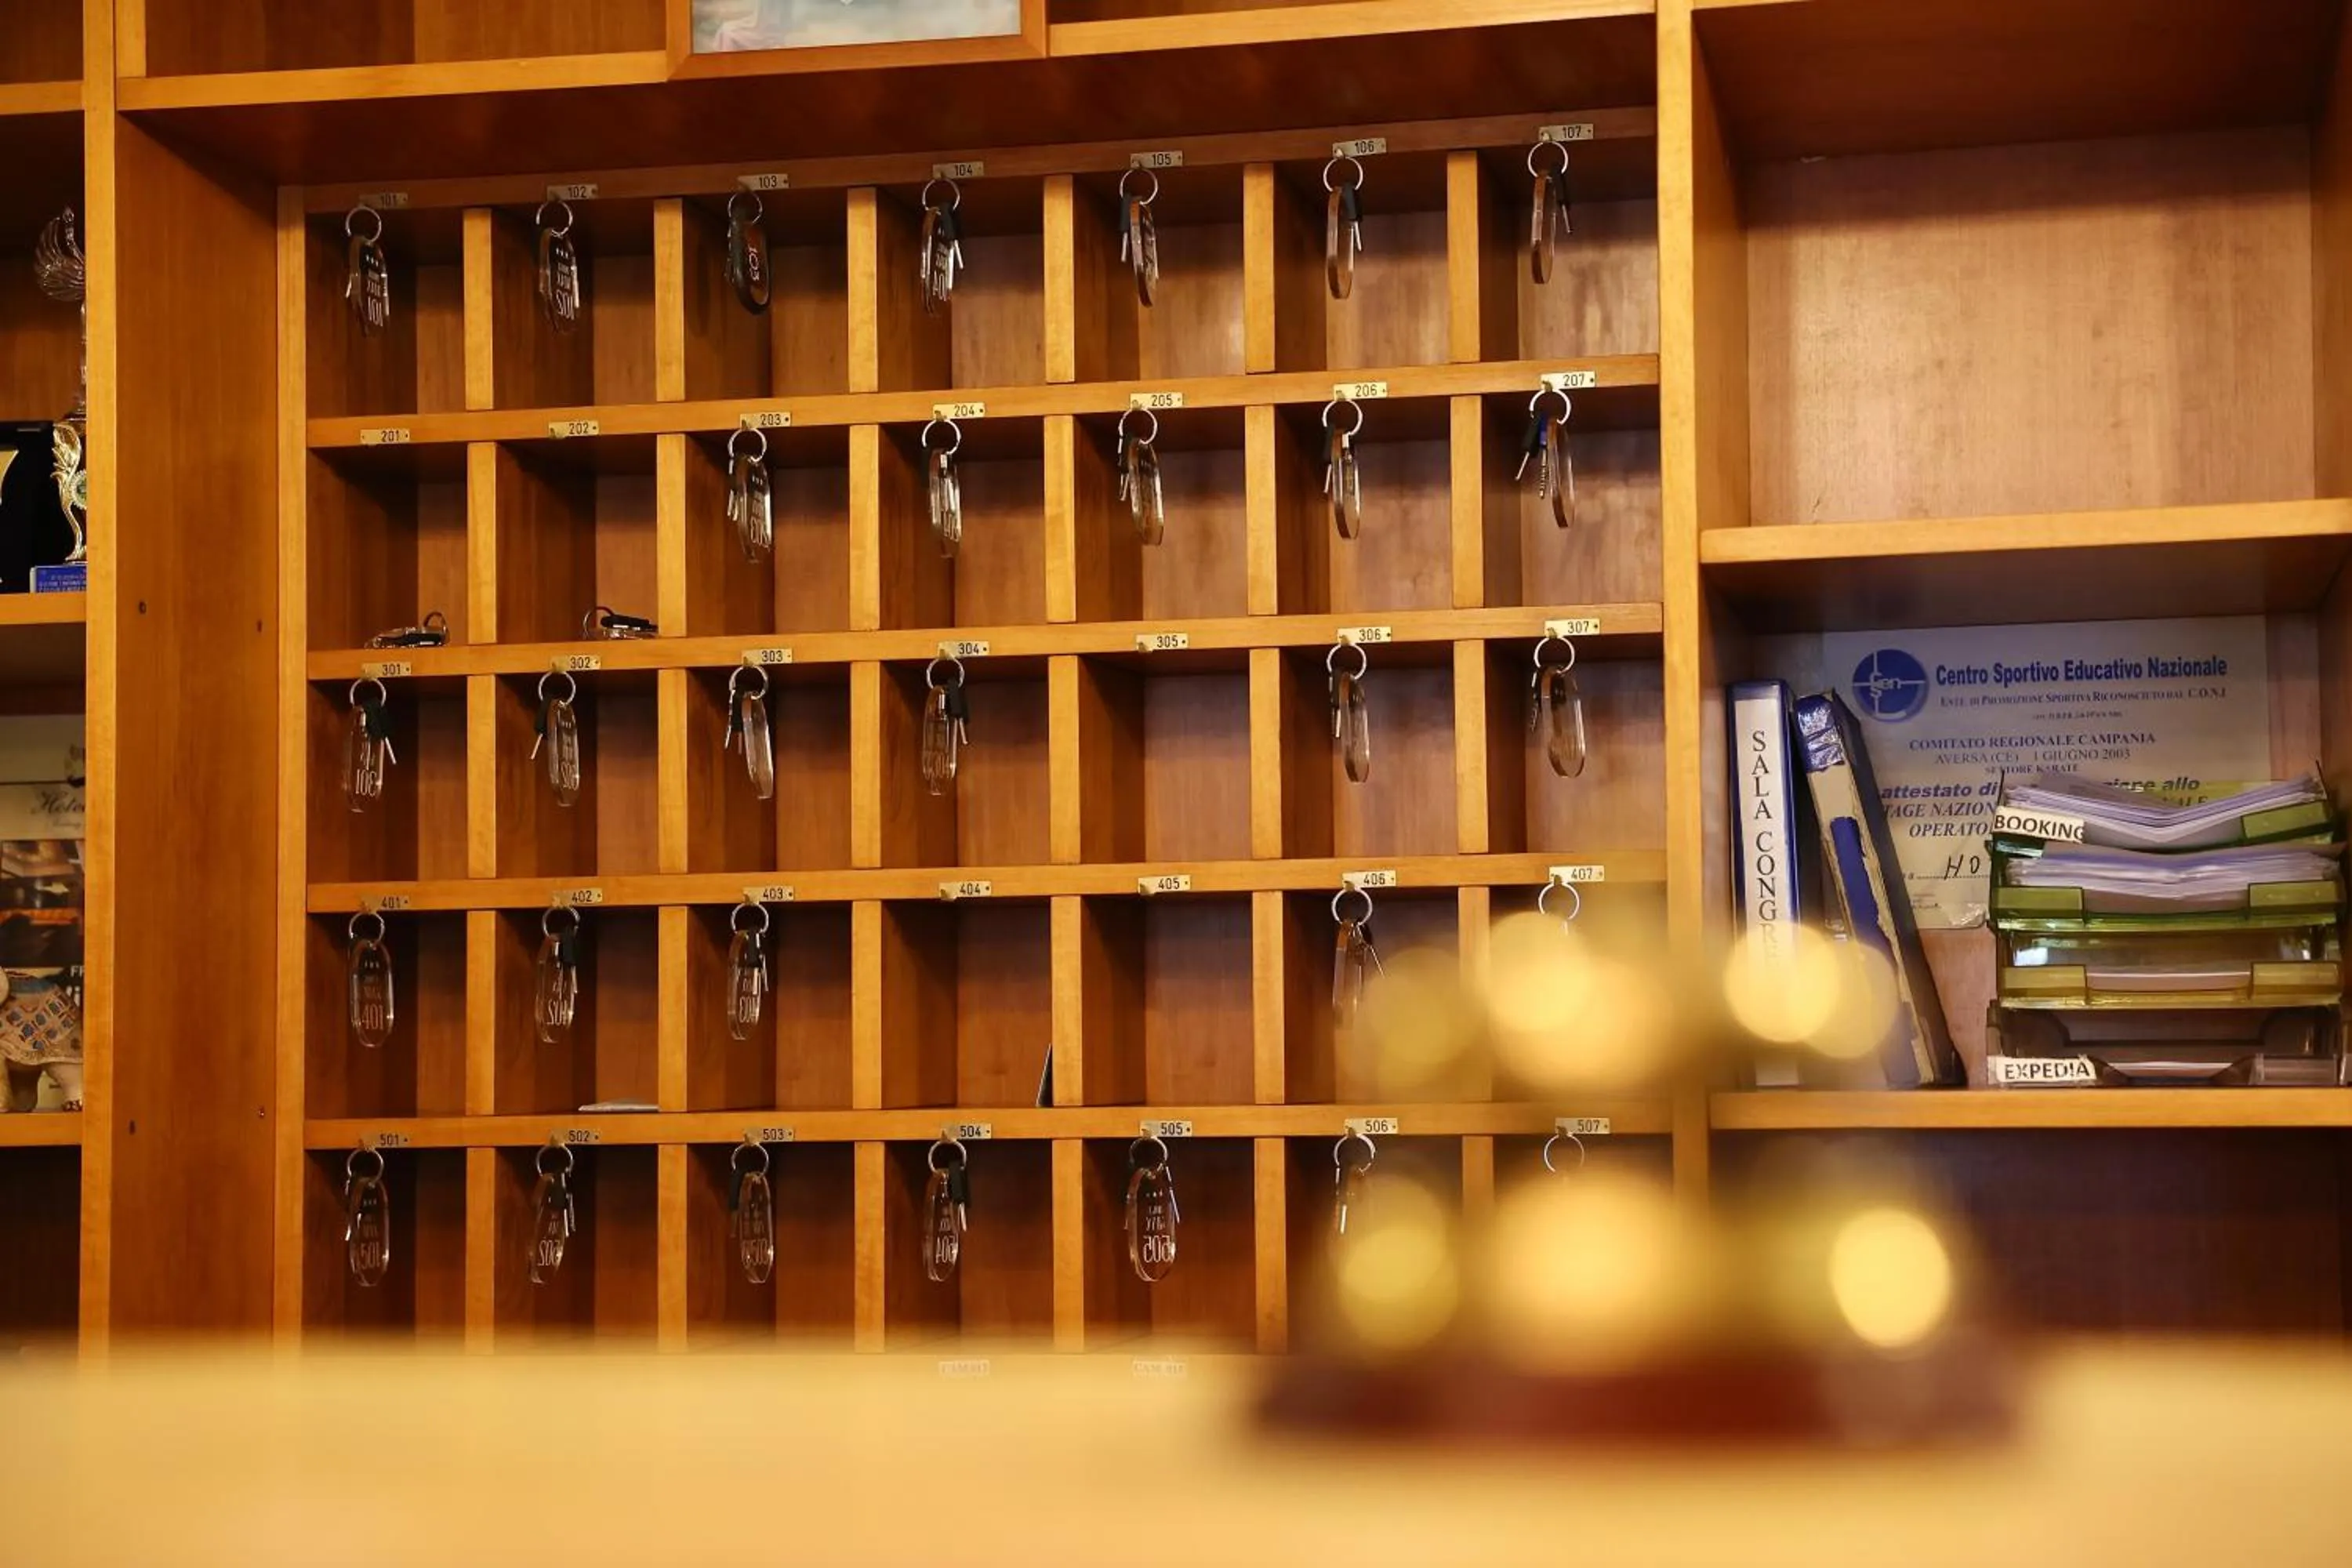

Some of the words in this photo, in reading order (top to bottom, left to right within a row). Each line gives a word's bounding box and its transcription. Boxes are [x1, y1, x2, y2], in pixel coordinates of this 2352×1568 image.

[1563, 125, 1581, 138] 107
[1355, 141, 1374, 153] 106
[1152, 154, 1171, 165] 105
[955, 164, 973, 176] 104
[759, 175, 777, 188] 103
[568, 186, 586, 198] 102
[380, 193, 397, 207] 101
[1563, 374, 1584, 387] 207
[1356, 384, 1377, 397] 206
[1152, 395, 1173, 406] 205
[954, 405, 975, 417] 204
[760, 414, 781, 426] 203
[569, 423, 589, 434] 202
[381, 430, 399, 442] 201
[1568, 621, 1588, 633] 307
[1359, 629, 1381, 641] 306
[1157, 636, 1178, 648] 305
[959, 643, 979, 655] 304
[570, 656, 590, 668] 302
[761, 651, 782, 662] 303
[383, 664, 401, 676] 301
[1936, 665, 1988, 685] Centro
[1993, 662, 2059, 688] Sportivo
[2064, 659, 2143, 681] Educativo
[2147, 655, 2227, 677] Nazionale
[1909, 738, 1985, 750] COMITATO
[1989, 735, 2074, 748] REGIONALE
[2078, 733, 2155, 745] CAMPANIA
[1935, 753, 1990, 764] AVERSA
[1991, 751, 2019, 763] (CE)
[2043, 750, 2099, 761] GIUGNO
[2102, 749, 2131, 760] 2003
[1751, 730, 1772, 820] SALA
[2162, 777, 2200, 790] allo
[1882, 782, 1972, 799] attestato
[1979, 782, 1998, 796] di
[1882, 803, 1926, 818] TAGE
[1930, 801, 1995, 817] NAZION
[1909, 822, 1992, 837] OPERATO
[1994, 815, 2084, 841] BOOKING
[1363, 873, 1385, 885] 406
[1571, 869, 1592, 880] 407
[960, 884, 980, 895] 404
[1158, 878, 1180, 889] 405
[572, 891, 592, 902] 402
[763, 887, 783, 899] 403
[382, 896, 400, 909] 401
[2005, 1062, 2090, 1080] EXPEDIA
[960, 1125, 981, 1137] 504
[1161, 1123, 1183, 1135] 505
[1366, 1120, 1388, 1132] 506
[1577, 1120, 1599, 1131] 507
[379, 1133, 399, 1146] 501
[568, 1130, 590, 1142] 502
[763, 1128, 784, 1140] 503
